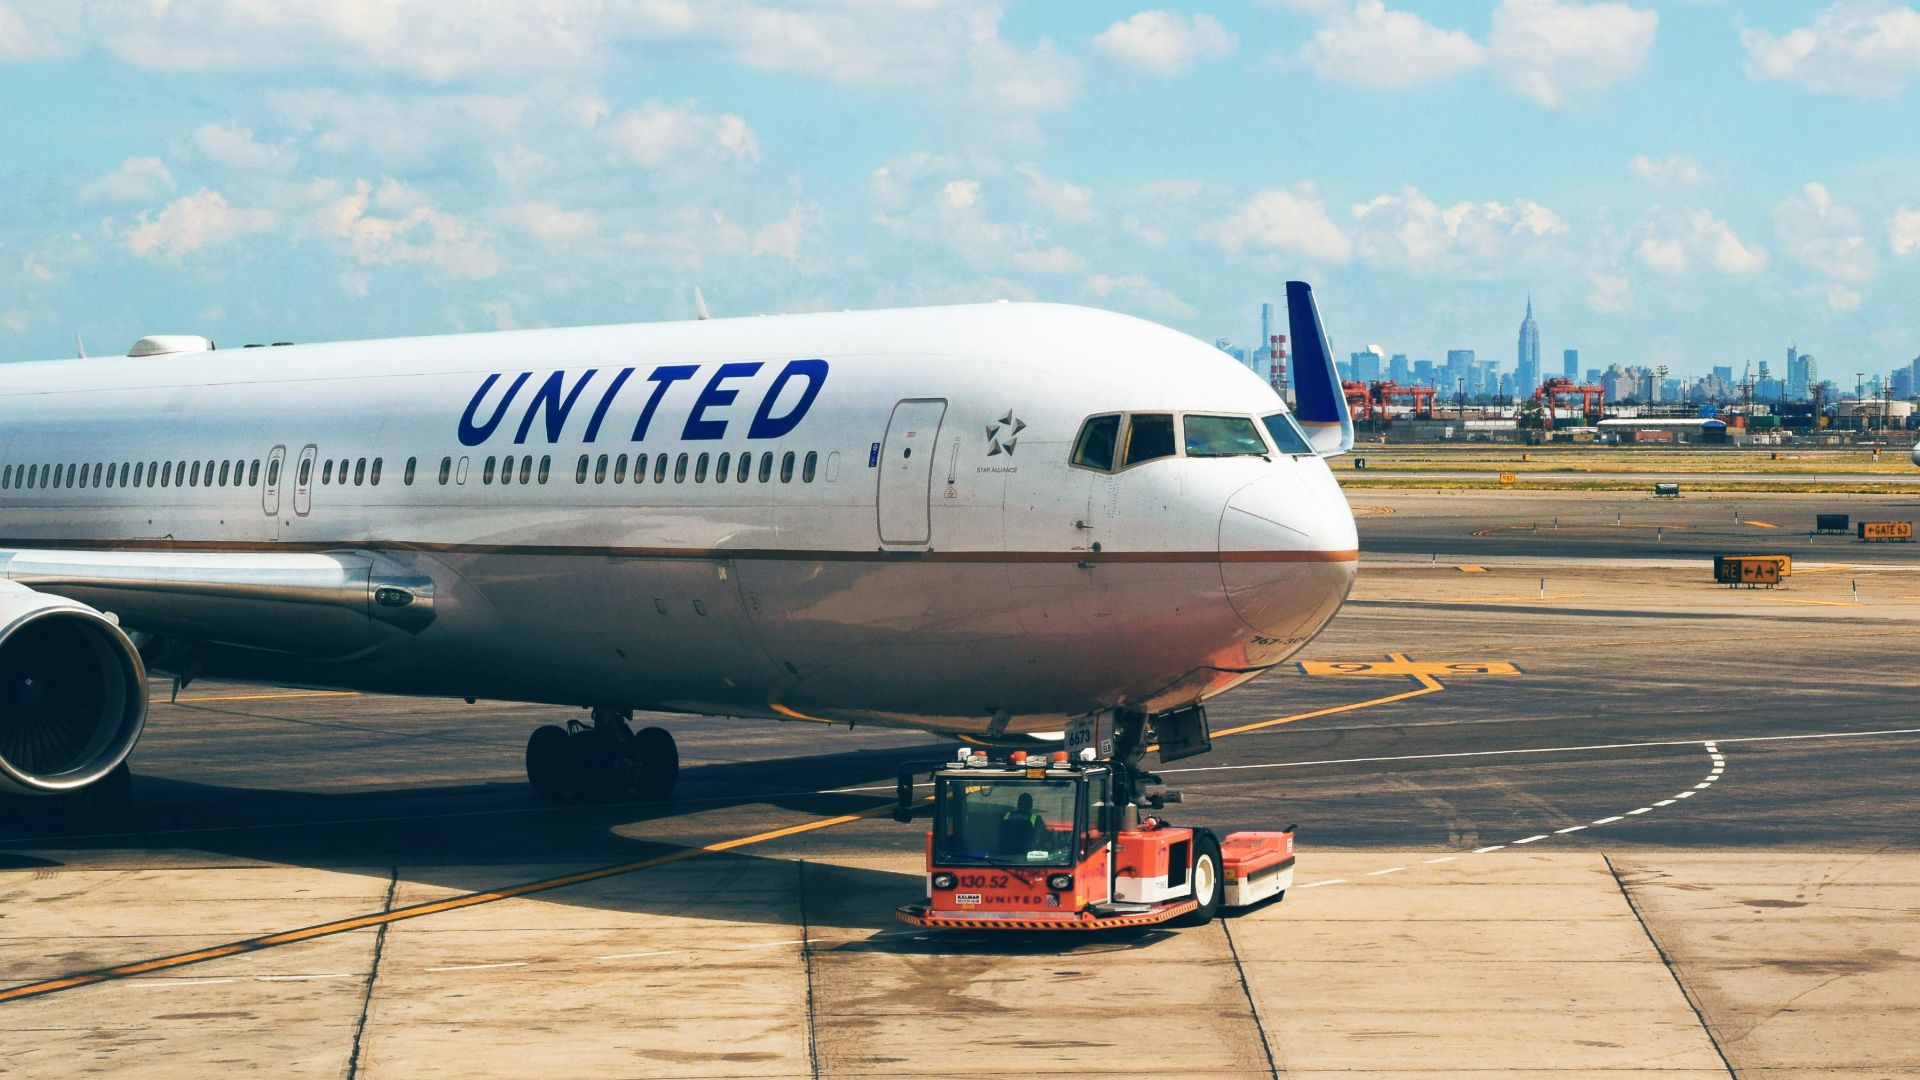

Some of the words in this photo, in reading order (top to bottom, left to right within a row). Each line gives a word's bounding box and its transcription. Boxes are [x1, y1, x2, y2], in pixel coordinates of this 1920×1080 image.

[458, 359, 829, 446] UNITED
[1875, 525, 1895, 535] GATE
[1897, 525, 1908, 535] 63
[1722, 564, 1737, 578] RE
[1755, 564, 1763, 578] A
[1069, 729, 1090, 746] 6673
[985, 895, 1042, 904] UNITED
